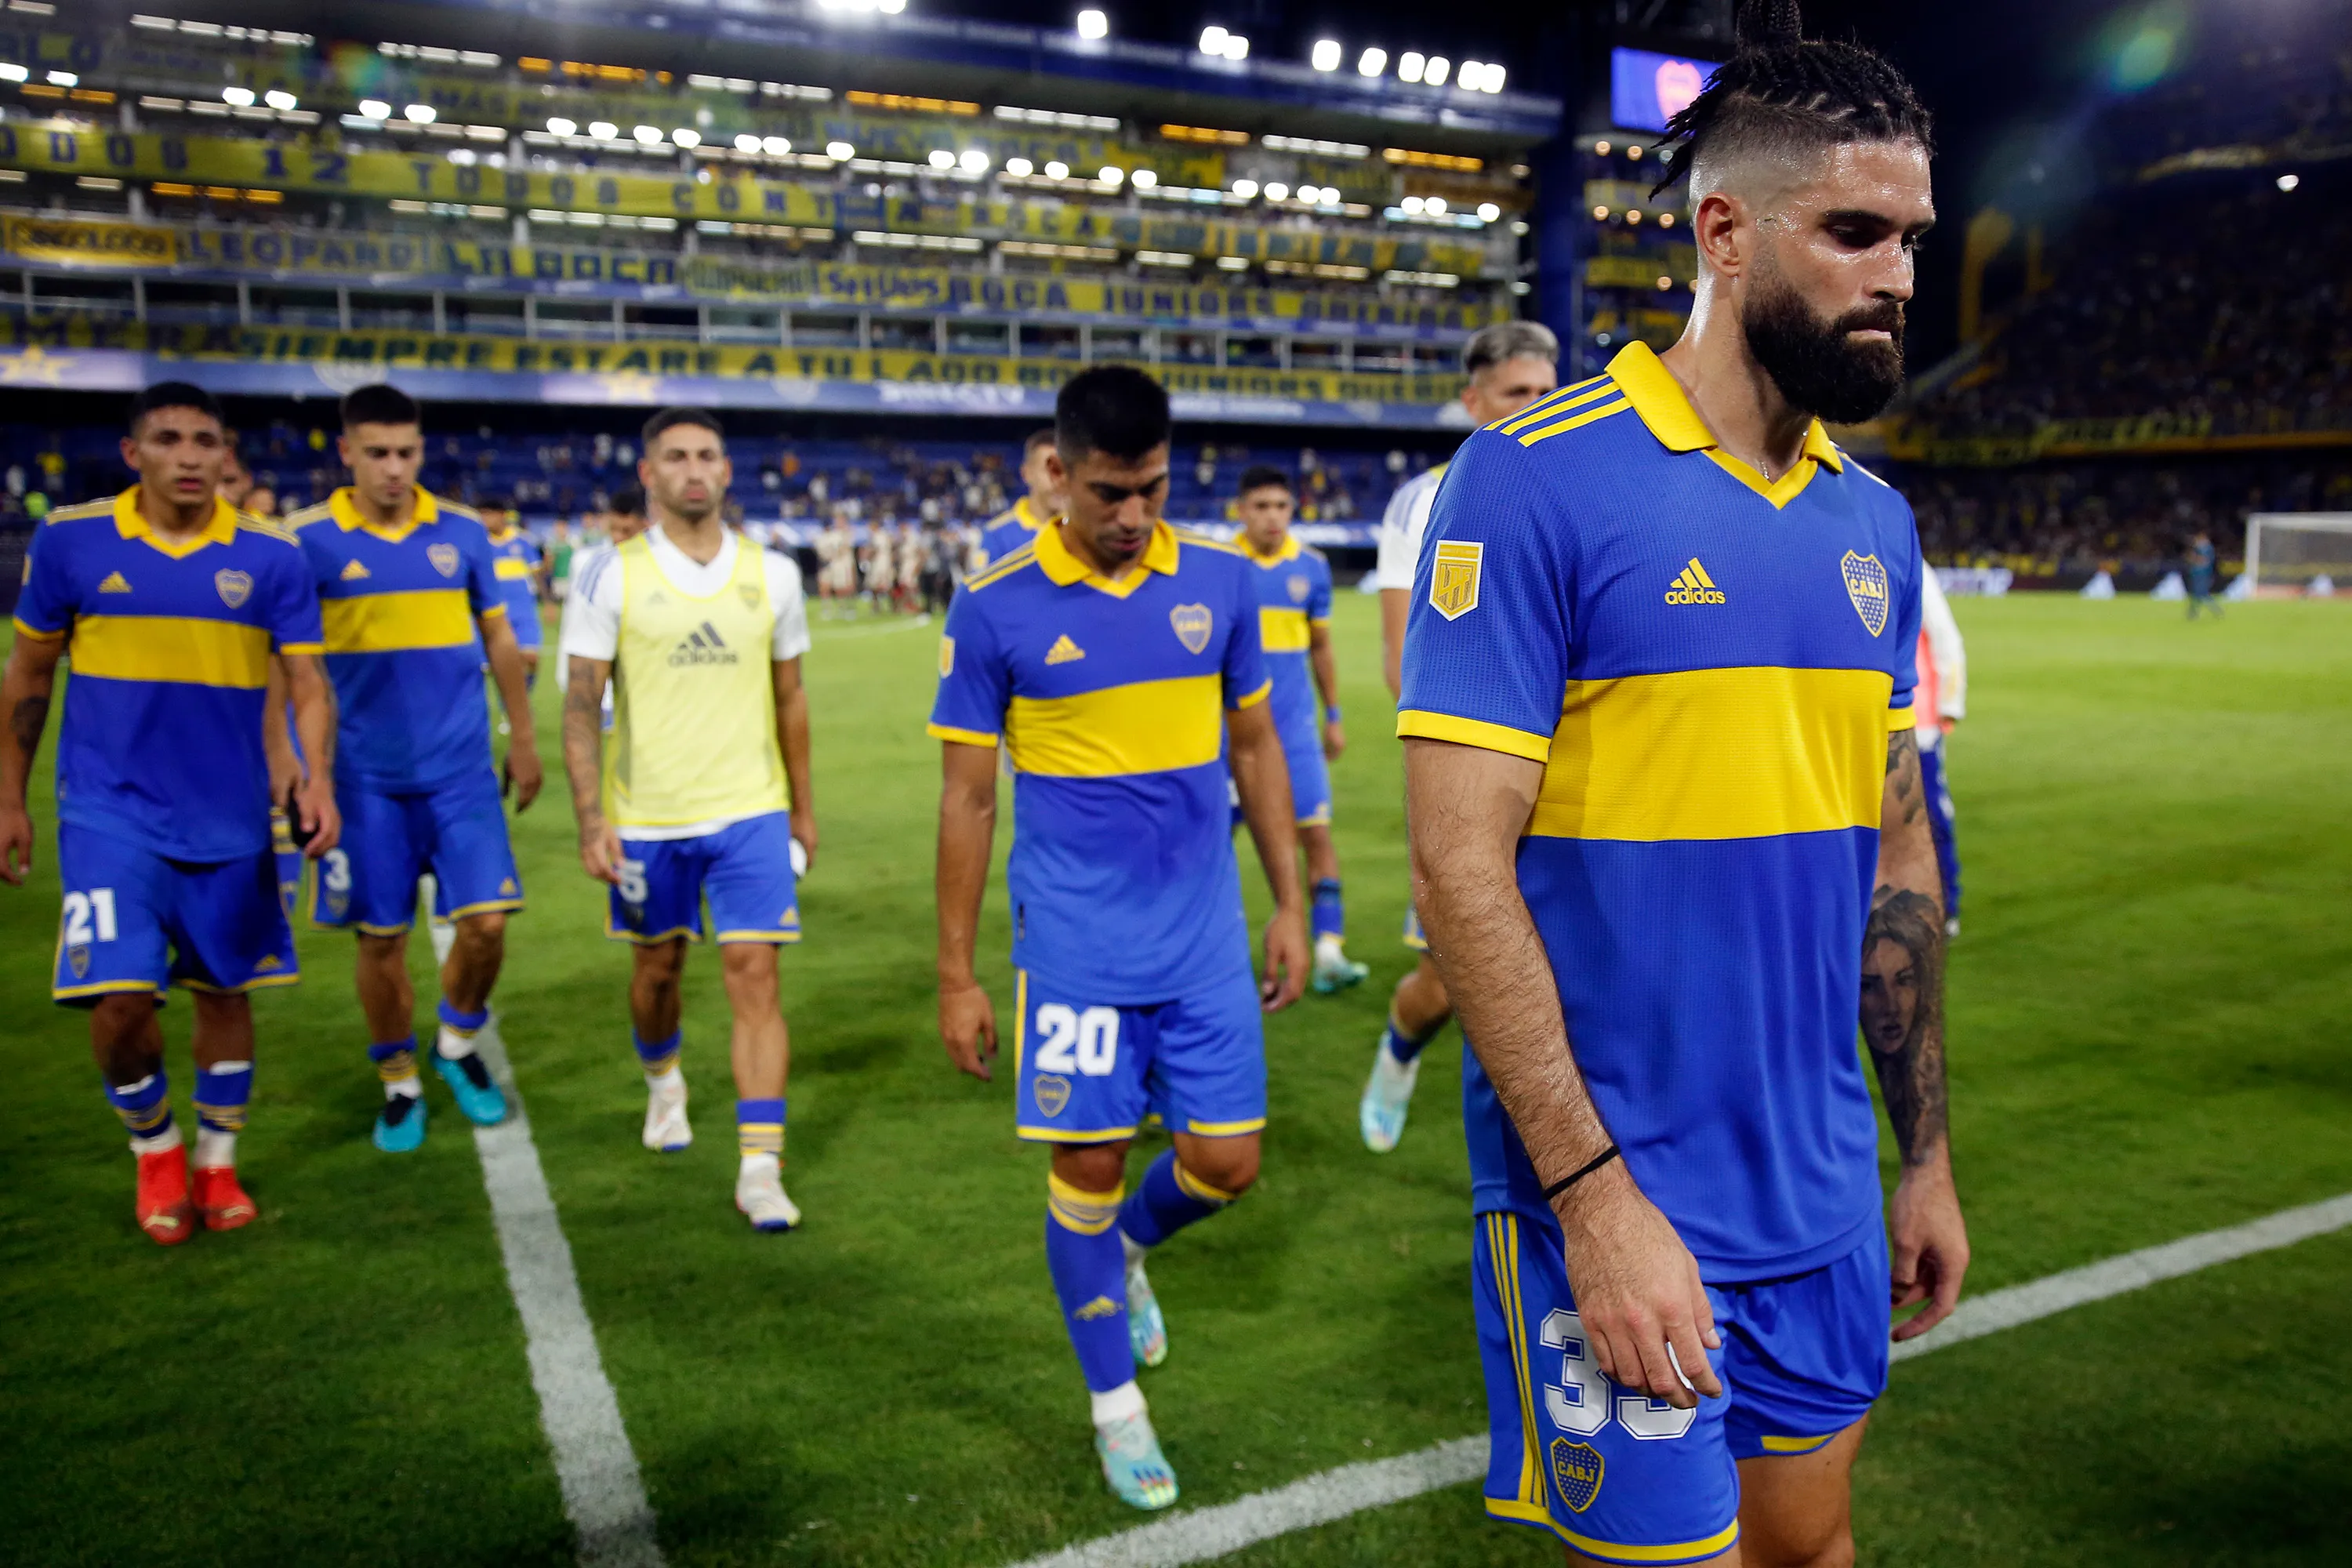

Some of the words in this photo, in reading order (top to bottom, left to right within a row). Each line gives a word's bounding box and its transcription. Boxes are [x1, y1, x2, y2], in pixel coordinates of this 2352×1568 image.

[1664, 586, 1726, 605] adidas
[1849, 578, 1885, 600] CABJ
[666, 646, 739, 668] adidas
[63, 887, 118, 949] 21
[1035, 1001, 1120, 1077] 20
[1558, 1461, 1595, 1483] CABJ
